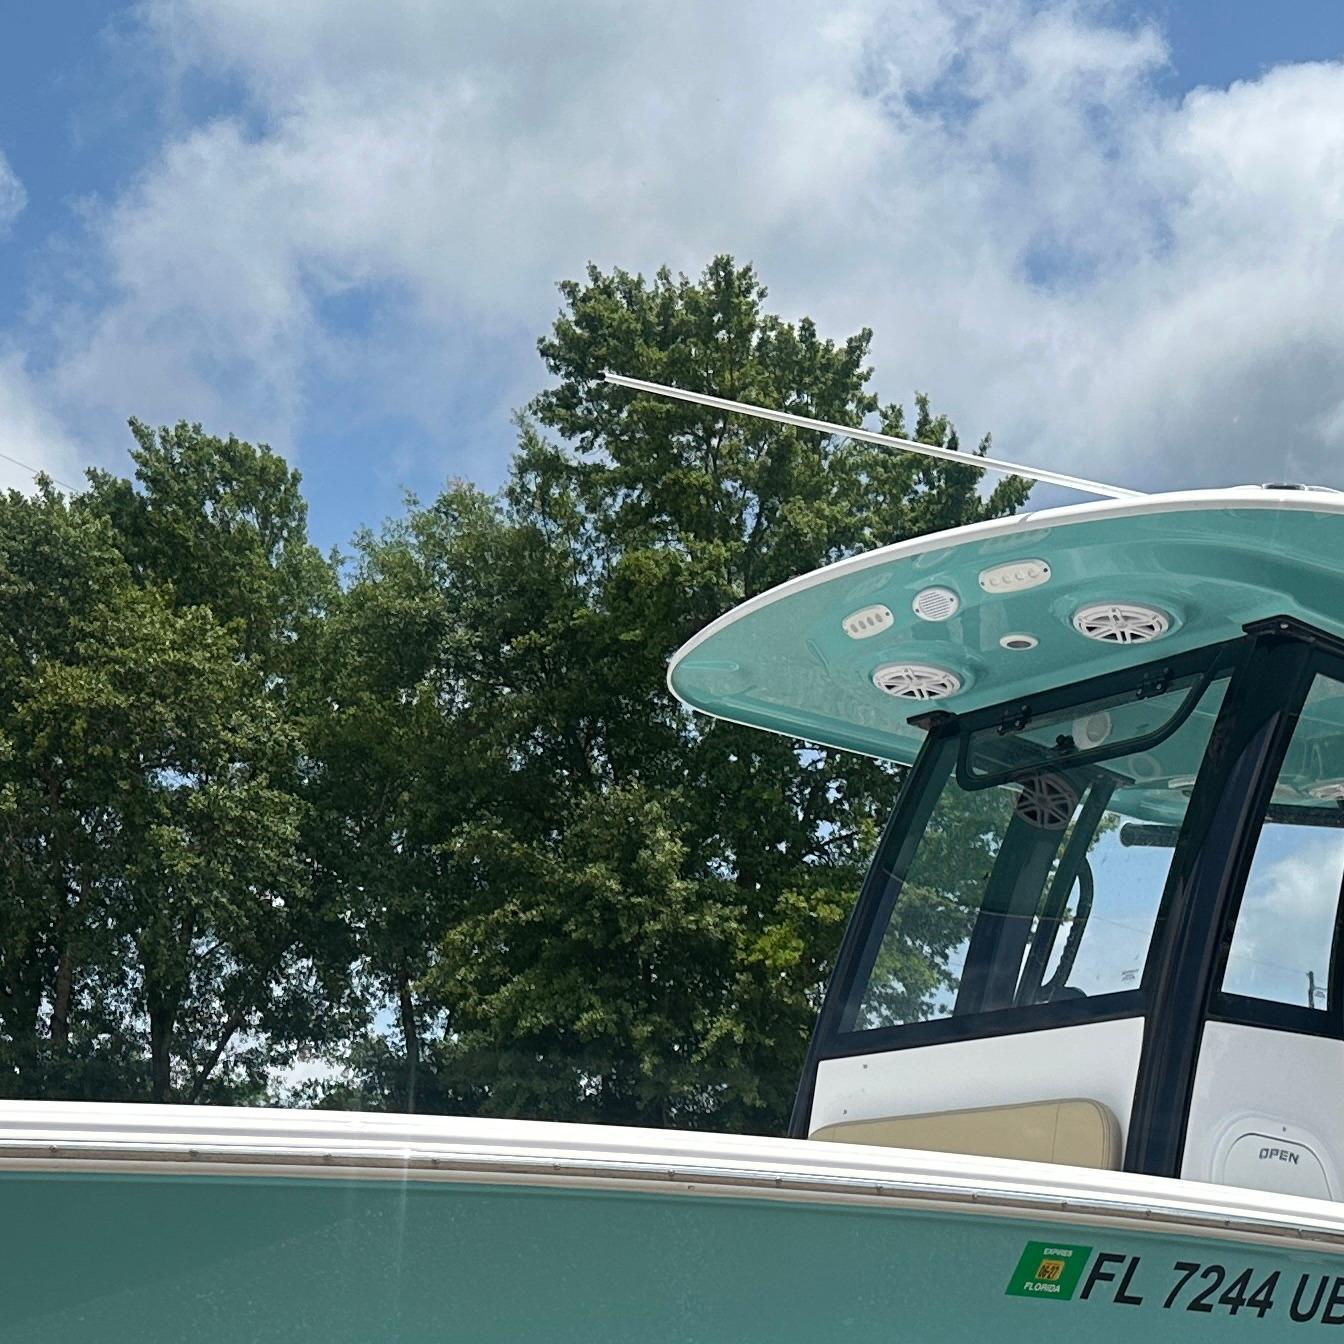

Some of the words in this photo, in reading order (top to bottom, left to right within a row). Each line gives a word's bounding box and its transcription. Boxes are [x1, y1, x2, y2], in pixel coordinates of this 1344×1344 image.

[1258, 1147, 1300, 1165] OPEN
[1023, 1281, 1061, 1293] FLORIDA
[1079, 1251, 1144, 1306] FL
[1162, 1260, 1282, 1319] 7244
